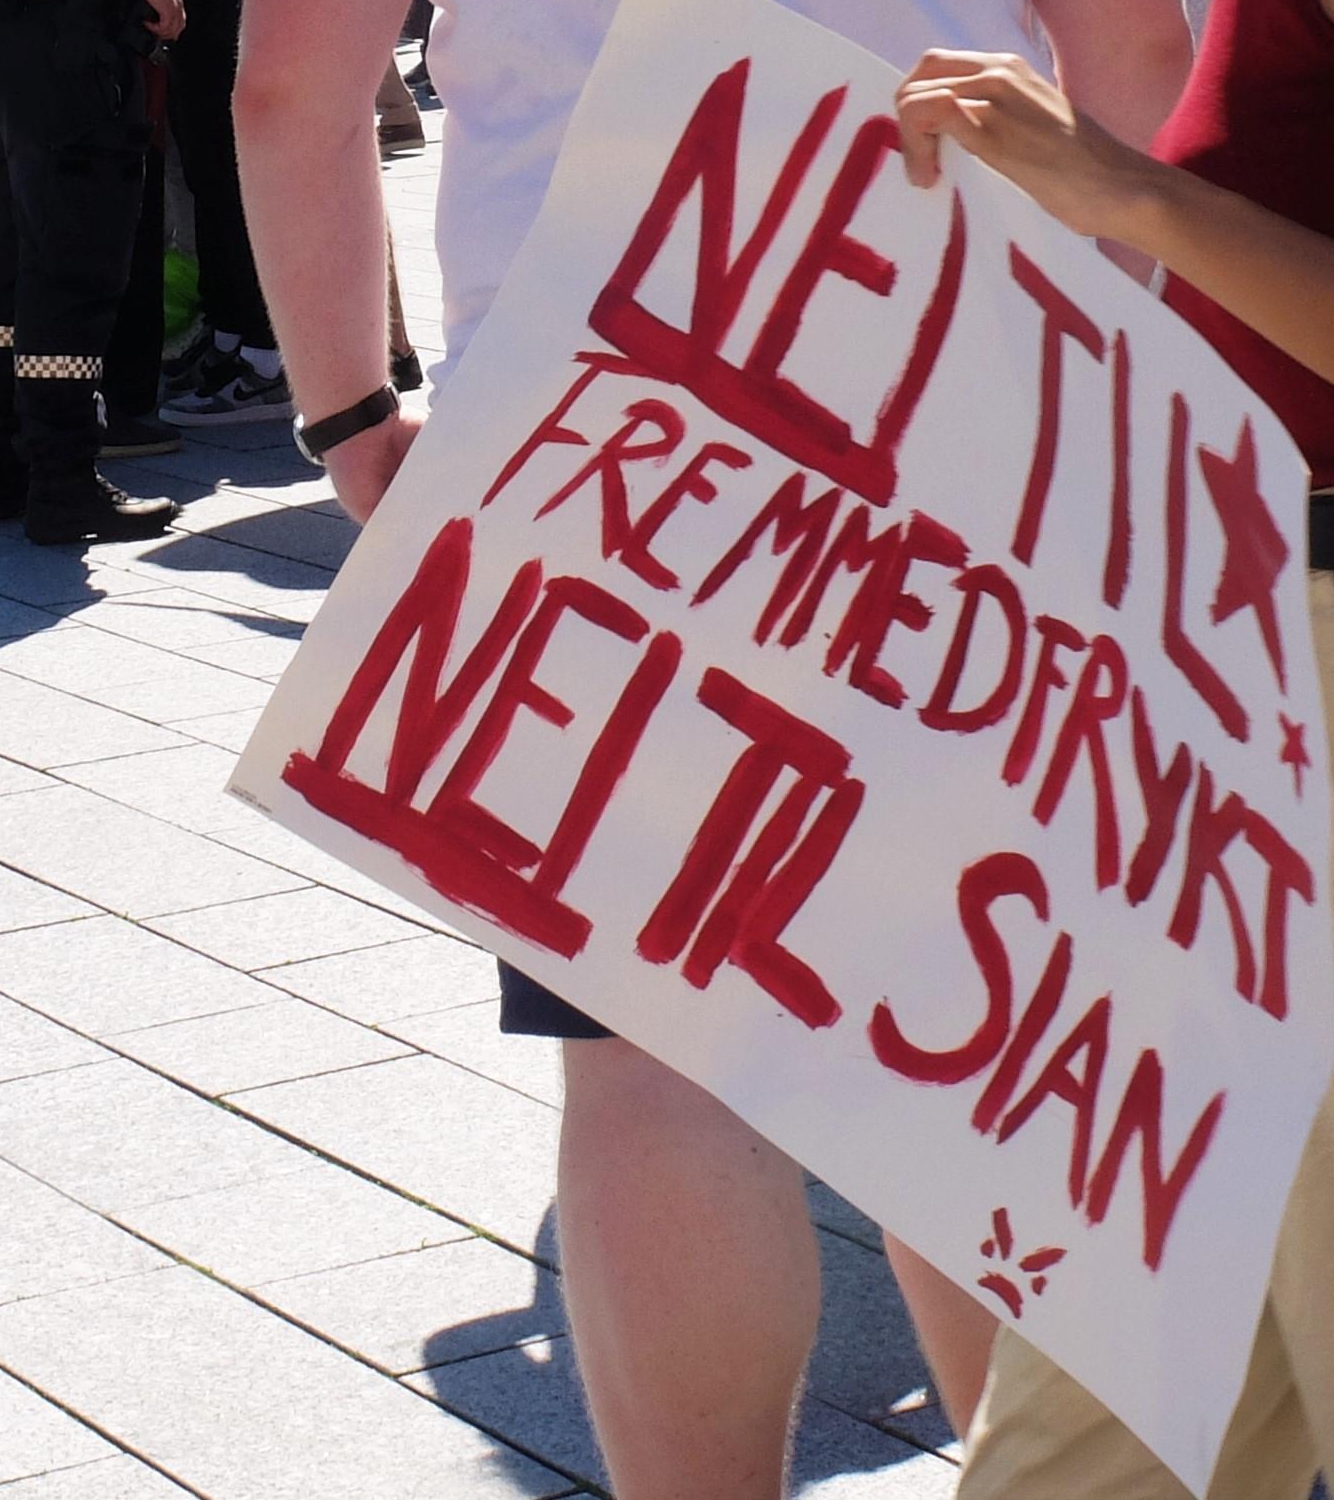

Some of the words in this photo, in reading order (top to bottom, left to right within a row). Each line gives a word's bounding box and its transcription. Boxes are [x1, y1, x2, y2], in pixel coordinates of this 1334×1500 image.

[481, 351, 1315, 1021] FREMMEDFRYKT
[588, 56, 967, 506] NEI
[1008, 240, 1249, 743] TIL
[282, 517, 685, 961] NEI
[636, 666, 868, 1031] TIL
[868, 852, 1226, 1274] SIAN
